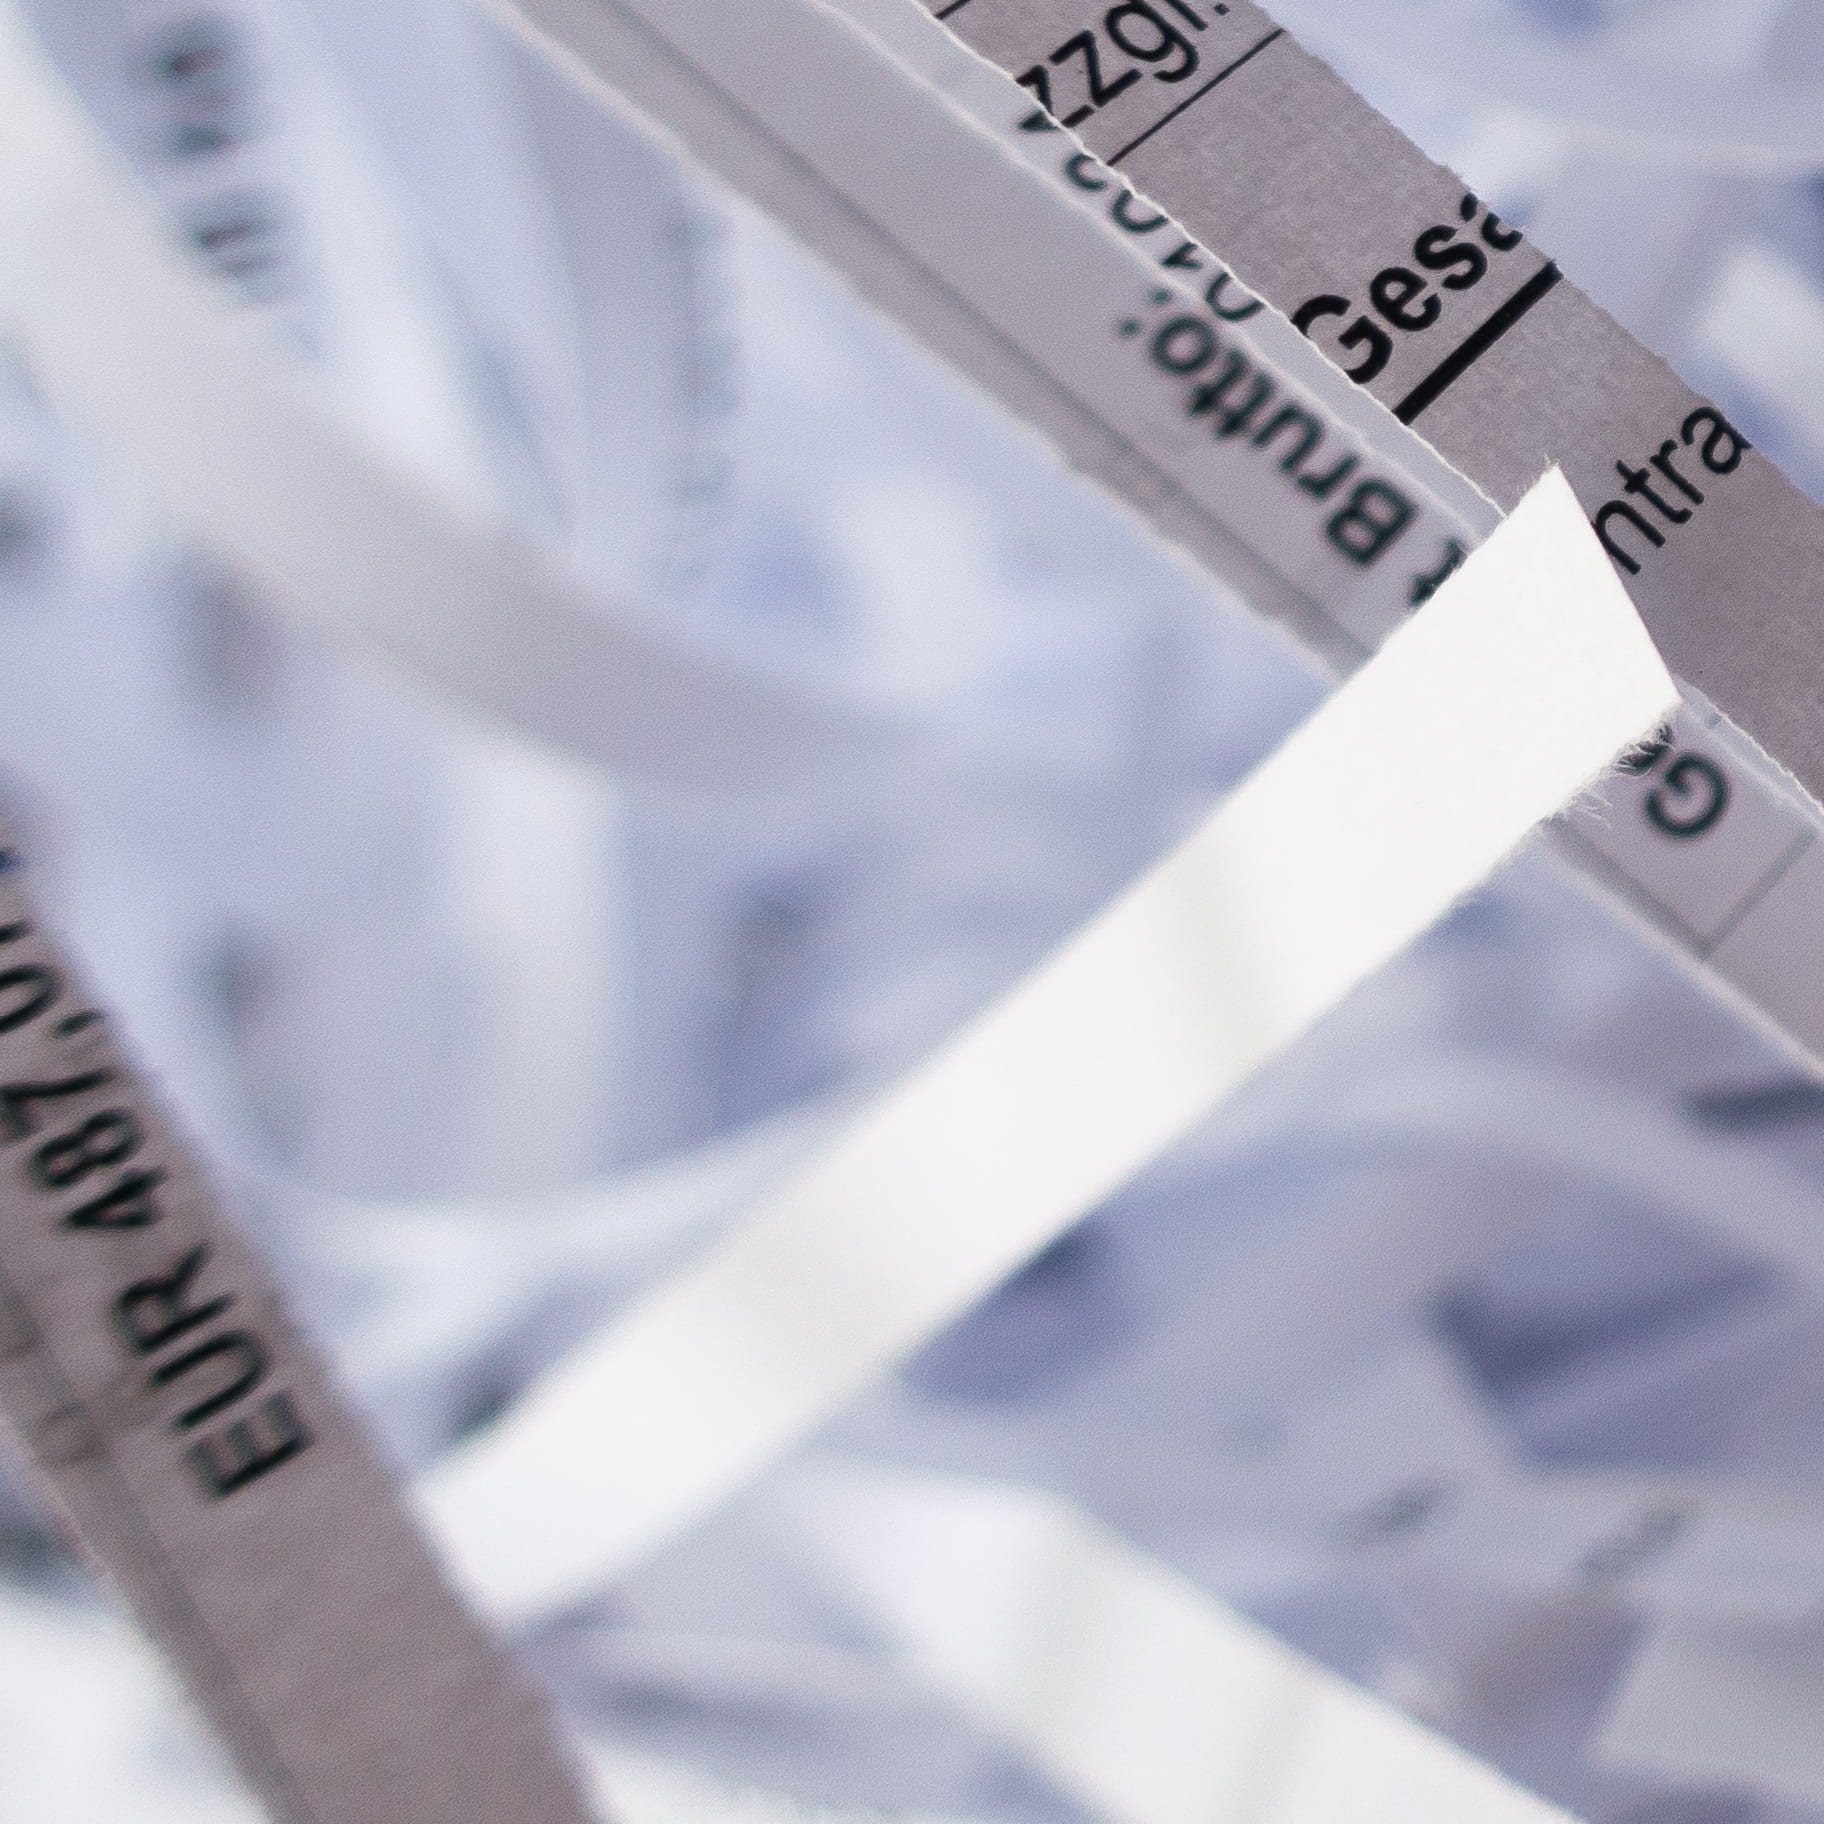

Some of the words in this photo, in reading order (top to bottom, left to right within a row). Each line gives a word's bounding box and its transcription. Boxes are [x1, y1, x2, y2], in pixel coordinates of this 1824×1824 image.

[1118, 288, 1416, 567] Brutto:
[0, 919, 164, 1233] 487,0
[110, 1244, 317, 1501] EUR
